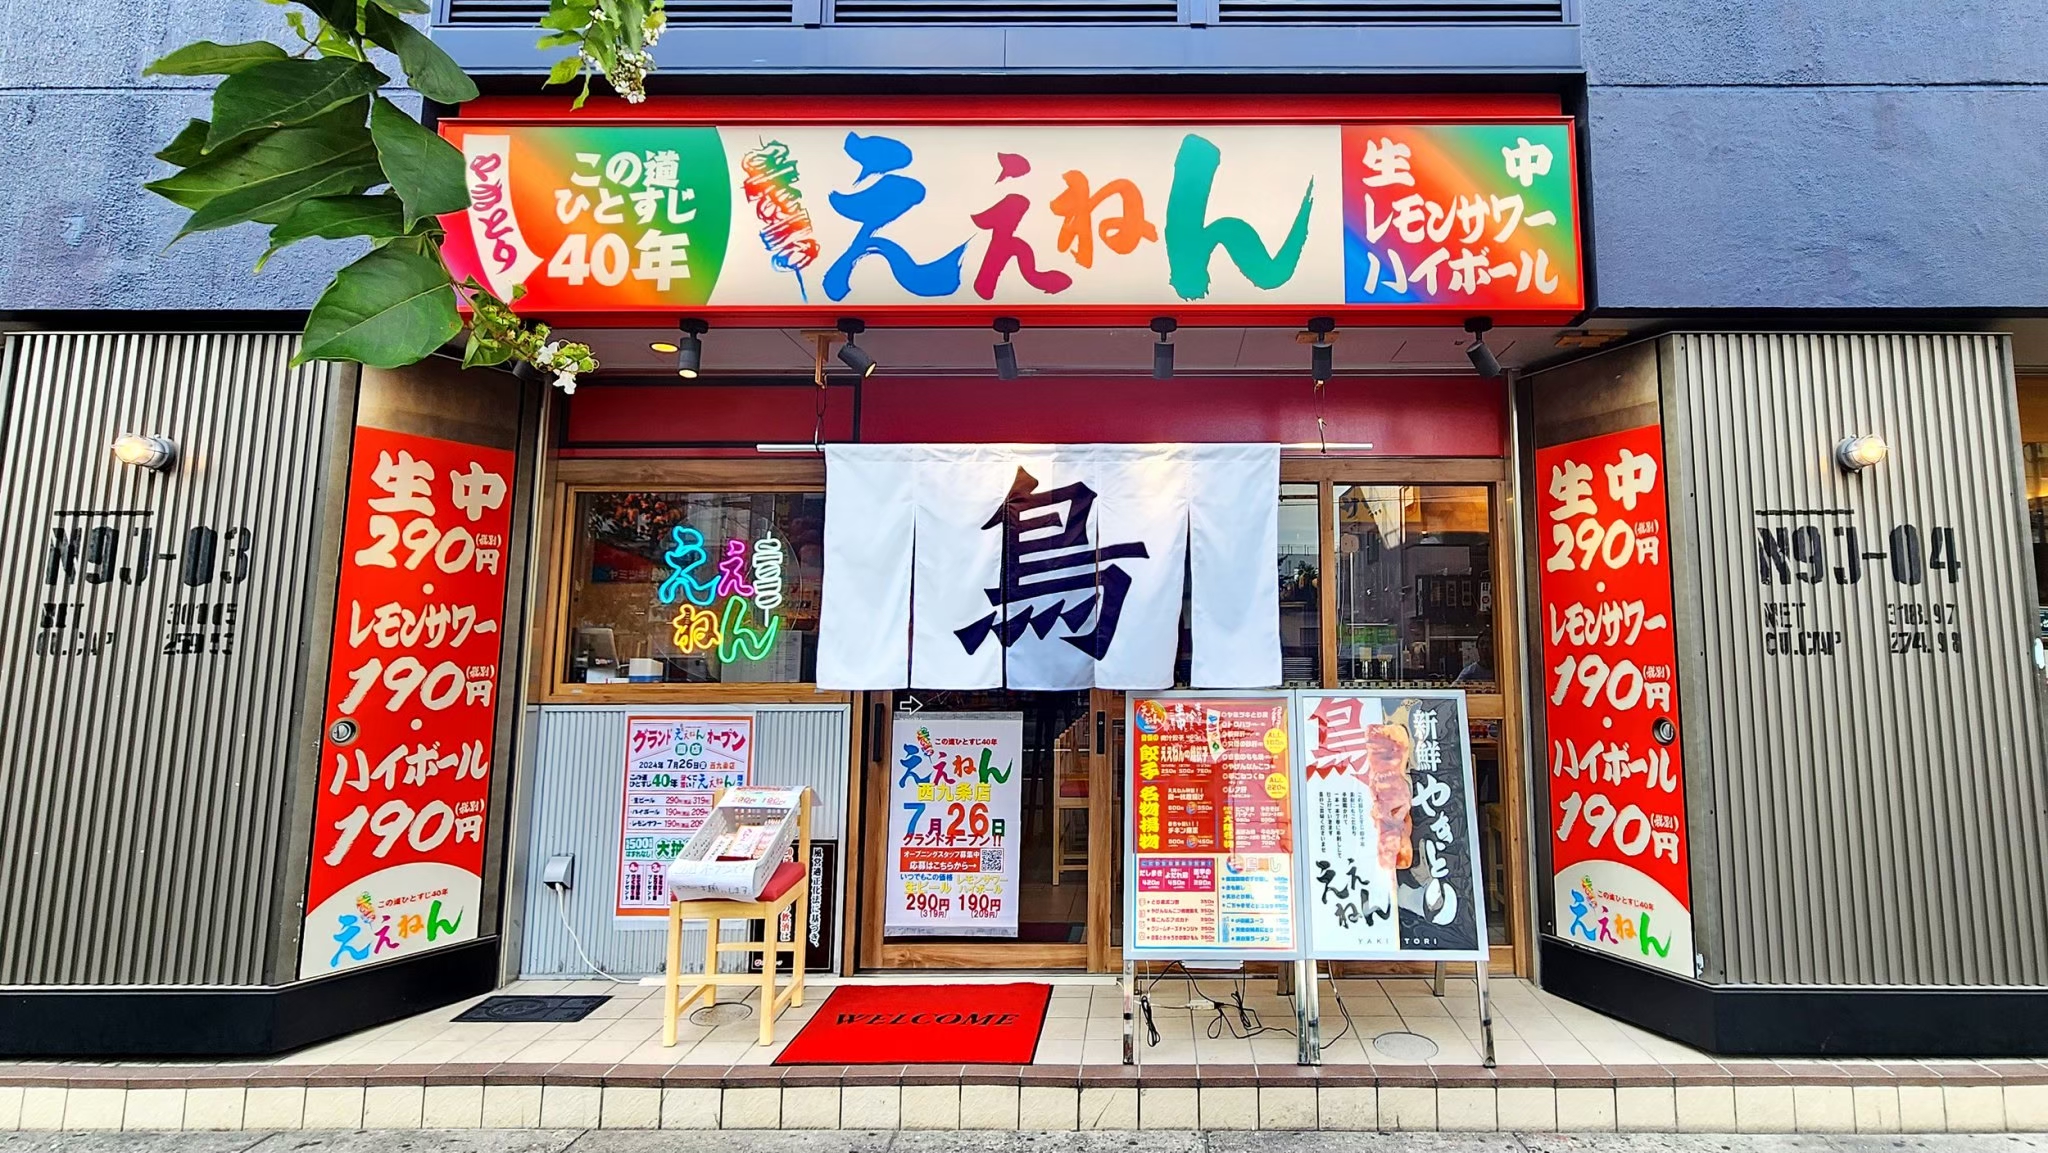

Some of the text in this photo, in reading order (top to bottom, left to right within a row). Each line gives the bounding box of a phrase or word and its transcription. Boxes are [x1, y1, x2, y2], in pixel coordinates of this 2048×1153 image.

[570, 150, 680, 188] この道
[469, 152, 518, 274] やきとり
[554, 187, 697, 225] ひとすじ
[822, 130, 1314, 302] ええねん
[1364, 193, 1558, 245] レモンサワー
[547, 229, 692, 291] 40年
[1364, 249, 1559, 297] ハイボール
[45, 525, 252, 587] N9J-03
[658, 524, 755, 606] ええ
[954, 465, 1150, 662] 鳥
[1757, 523, 1963, 587] N9J-04
[349, 599, 498, 649] レモンサワー
[672, 594, 779, 664] ねん
[1549, 599, 1667, 648] レモンサワー
[1764, 602, 1807, 629] NET
[1765, 631, 1842, 656] CU.CAP
[633, 728, 673, 754] グランド
[666, 759, 708, 771] 7月26日
[1412, 709, 1442, 772] 新鮮
[329, 739, 489, 796] ハイボール
[652, 774, 679, 789] 40年
[898, 743, 1014, 789] ええねん
[1553, 737, 1678, 794] ハイボール
[917, 782, 992, 803] 西九条店
[903, 802, 1006, 838] 7月26日
[1411, 774, 1459, 926] やきとり
[900, 873, 954, 882] いつでもこの価格
[904, 881, 952, 894] 生ビール
[906, 893, 1002, 911] 290円 190円
[329, 899, 465, 968] ええねん
[1404, 937, 1439, 945] TORI
[1568, 888, 1673, 959] ええねん
[835, 1013, 1019, 1026] WELCOME
